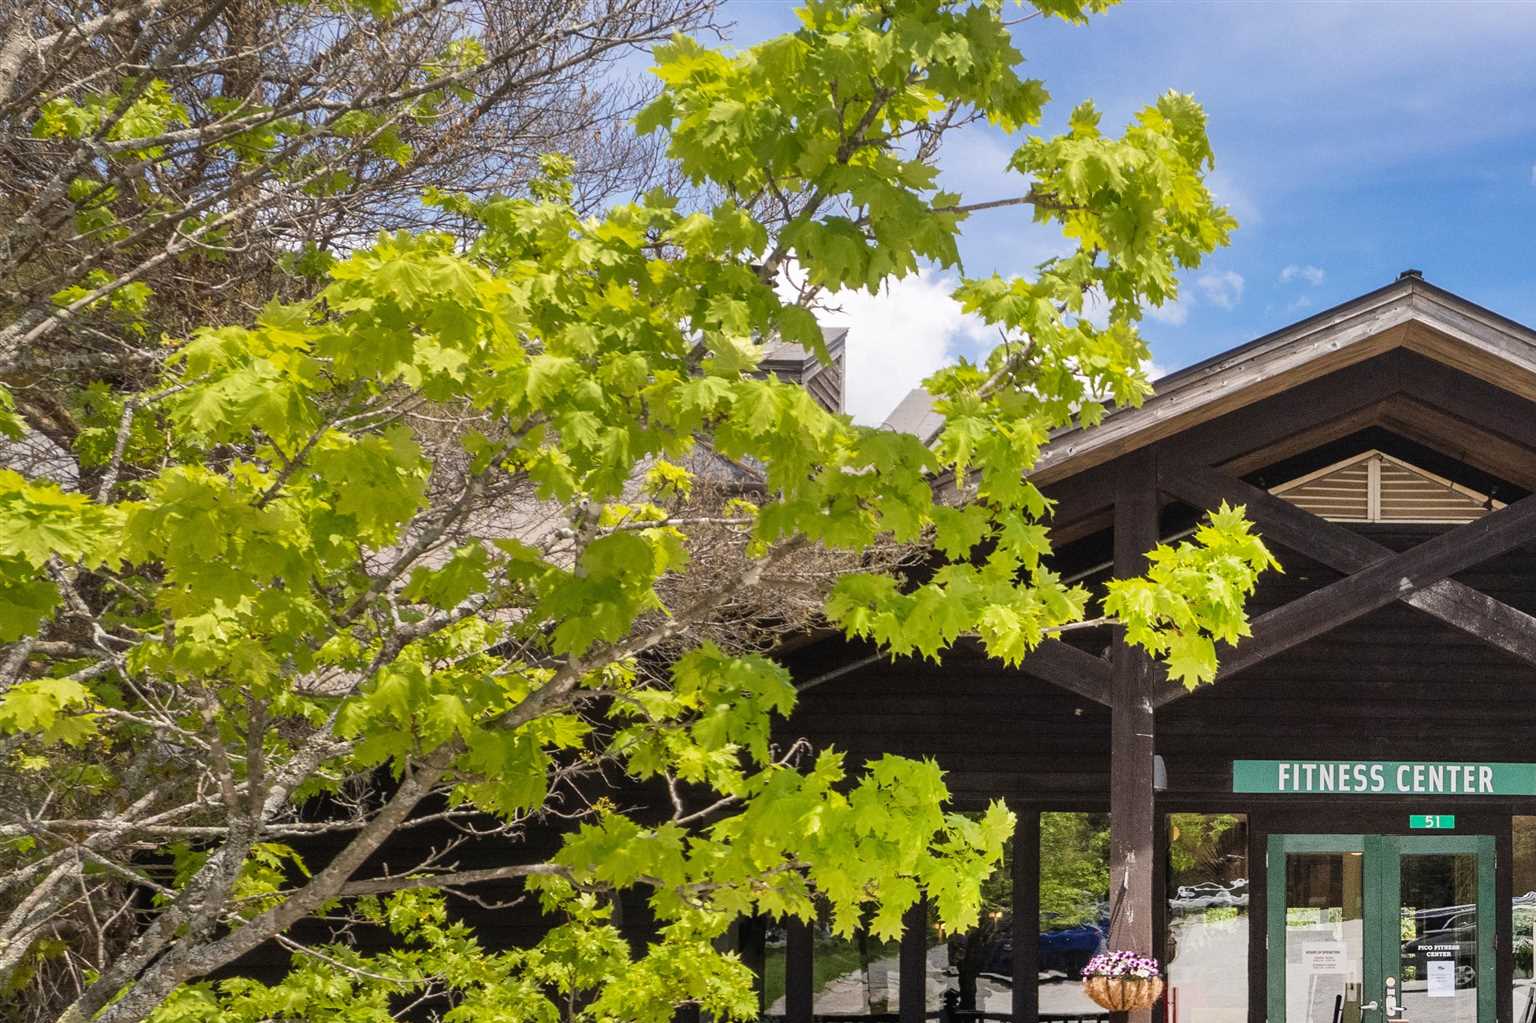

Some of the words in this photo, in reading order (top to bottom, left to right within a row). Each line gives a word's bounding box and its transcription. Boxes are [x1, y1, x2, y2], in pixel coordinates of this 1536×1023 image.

[1278, 763, 1385, 793] FITNESS
[1396, 765, 1494, 793] CENTER
[1425, 815, 1440, 828] 51
